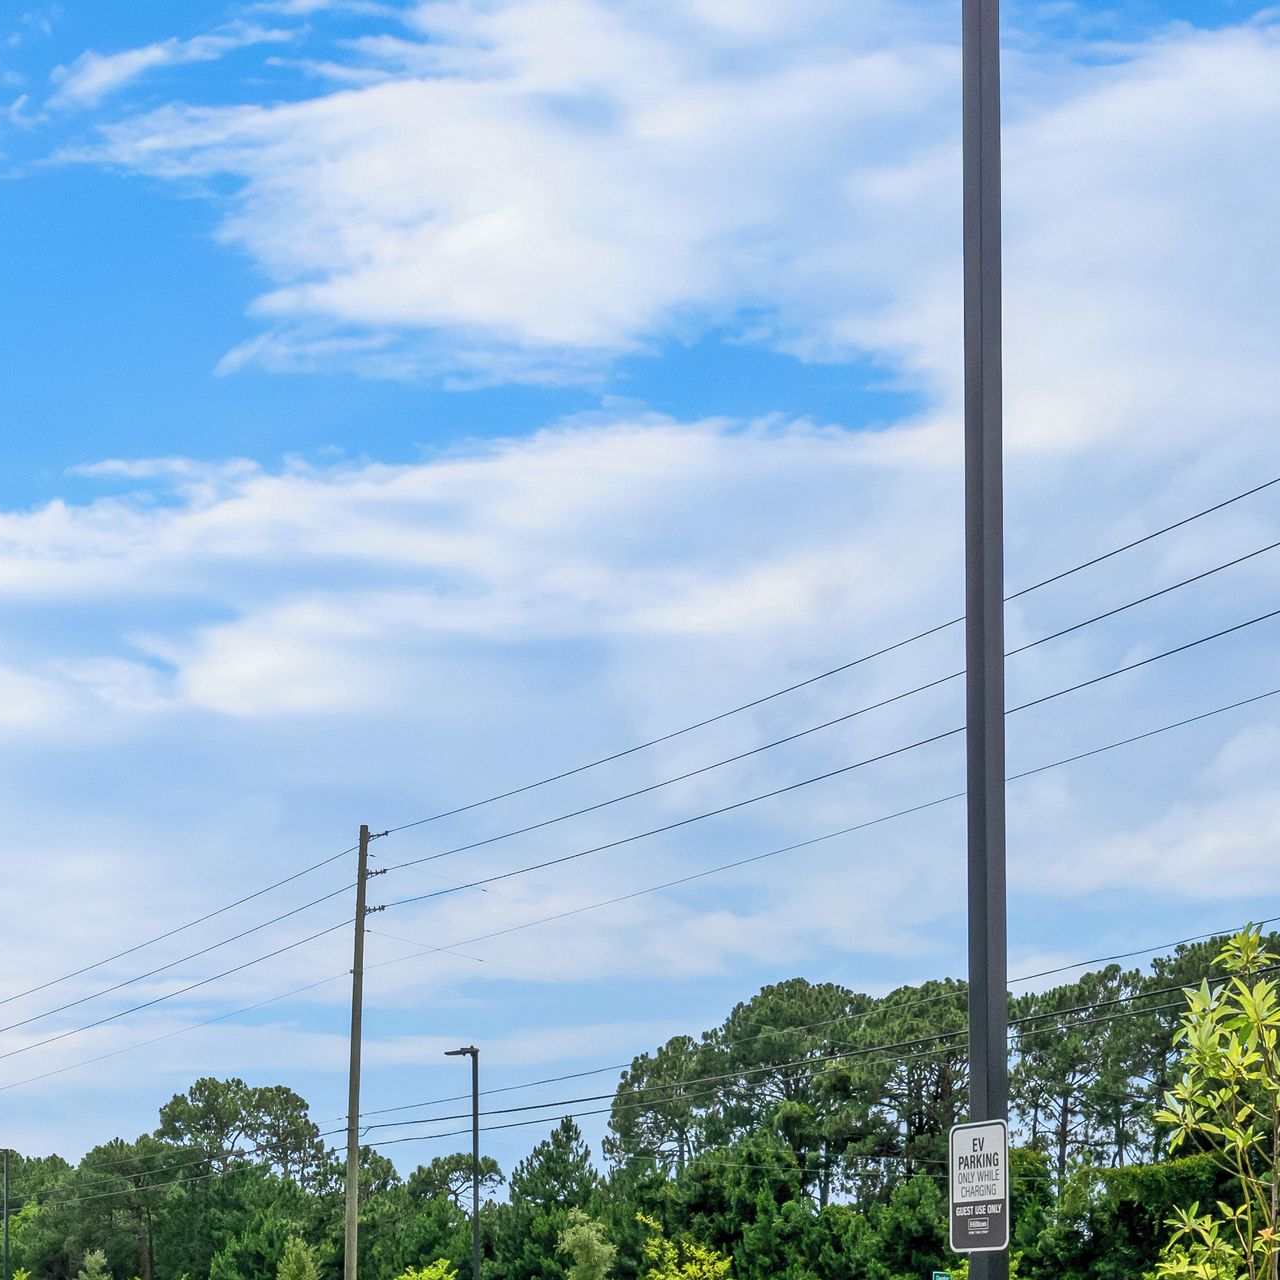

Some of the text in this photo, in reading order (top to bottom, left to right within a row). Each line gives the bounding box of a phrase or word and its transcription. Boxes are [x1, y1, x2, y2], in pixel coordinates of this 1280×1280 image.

[972, 1137, 985, 1153] EV
[958, 1152, 999, 1170] PARKING
[957, 1169, 1000, 1185] ONLY WHILE
[961, 1183, 997, 1198] CHARGING
[955, 1203, 1002, 1216] GUEST USE ONLY
